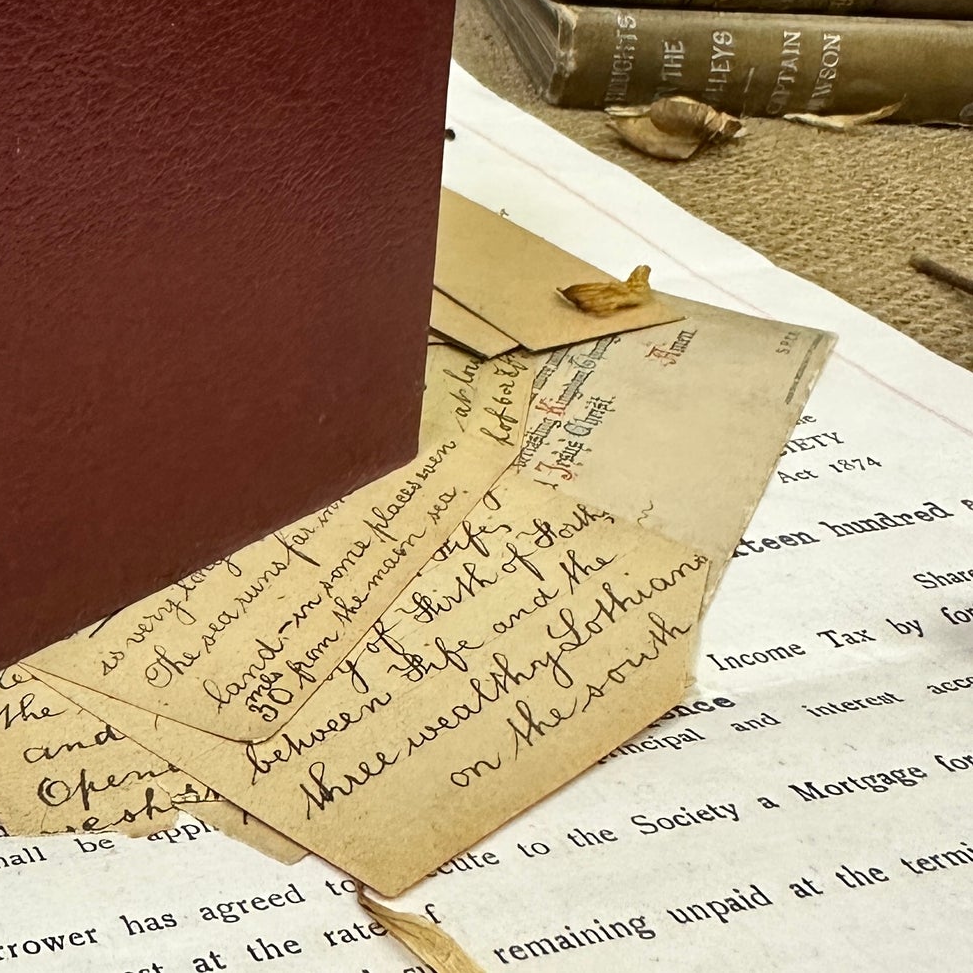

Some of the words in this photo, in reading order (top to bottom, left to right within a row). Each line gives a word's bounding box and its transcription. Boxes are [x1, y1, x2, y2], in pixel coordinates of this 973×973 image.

[662, 38, 686, 81] THE
[777, 468, 819, 484] Act
[828, 456, 883, 474] 1874
[817, 501, 955, 538] hundred
[502, 542, 546, 582] of
[492, 588, 560, 634] and
[559, 549, 619, 596] the
[144, 644, 201, 689] The
[707, 639, 807, 672] Income
[817, 627, 878, 649] Tax
[886, 618, 924, 638] by
[450, 751, 502, 788] on
[507, 697, 578, 762] the
[581, 611, 693, 713] south
[731, 713, 782, 733] and
[801, 691, 905, 718] interest
[23, 725, 127, 764] and
[300, 749, 402, 821] three
[407, 650, 574, 756] wealthy
[74, 836, 116, 854] be
[119, 911, 179, 937] has
[199, 883, 307, 923] agreed
[326, 879, 358, 897] to
[517, 842, 551, 858] to
[567, 828, 620, 849] the
[630, 801, 741, 836] Society
[757, 796, 781, 810] a
[788, 763, 929, 803] Mortgage
[192, 950, 228, 973] at
[246, 938, 303, 963] the
[323, 922, 389, 947] rate
[493, 915, 657, 966] remaining
[667, 884, 774, 924] unpaid
[789, 877, 824, 900] at
[835, 864, 890, 890] the
